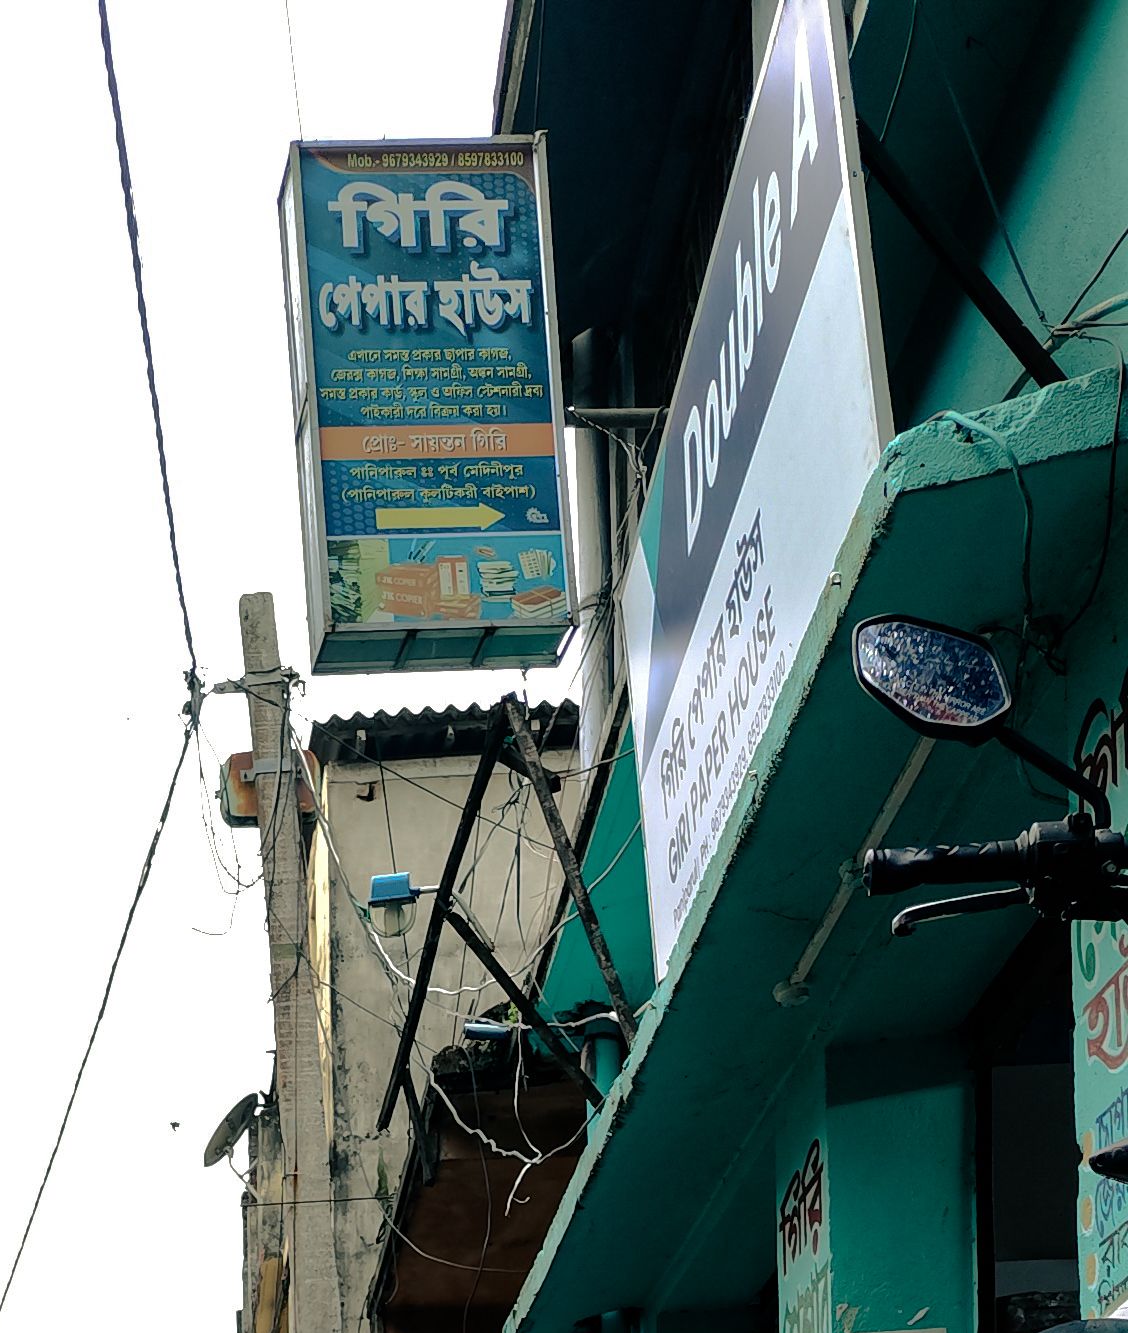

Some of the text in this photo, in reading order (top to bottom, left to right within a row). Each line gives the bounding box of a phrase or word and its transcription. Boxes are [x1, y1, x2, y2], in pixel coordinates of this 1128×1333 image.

[382, 153, 449, 168] 9679343929
[457, 151, 524, 167] 8597833100
[328, 180, 509, 249] গিরি
[319, 260, 532, 338] পেপার হাউস
[682, 19, 820, 557] Double A
[360, 403, 404, 419] পাইকারী
[470, 427, 508, 452] গিরি
[349, 464, 417, 481] পানিপারুল
[437, 461, 460, 480] পূর্ব
[463, 461, 524, 481] মেদিনীপুর
[660, 507, 765, 820] গিরি পেপার হাউস
[668, 584, 776, 884] GIRI PAPER HOUSE
[779, 1138, 824, 1277] গিরি
